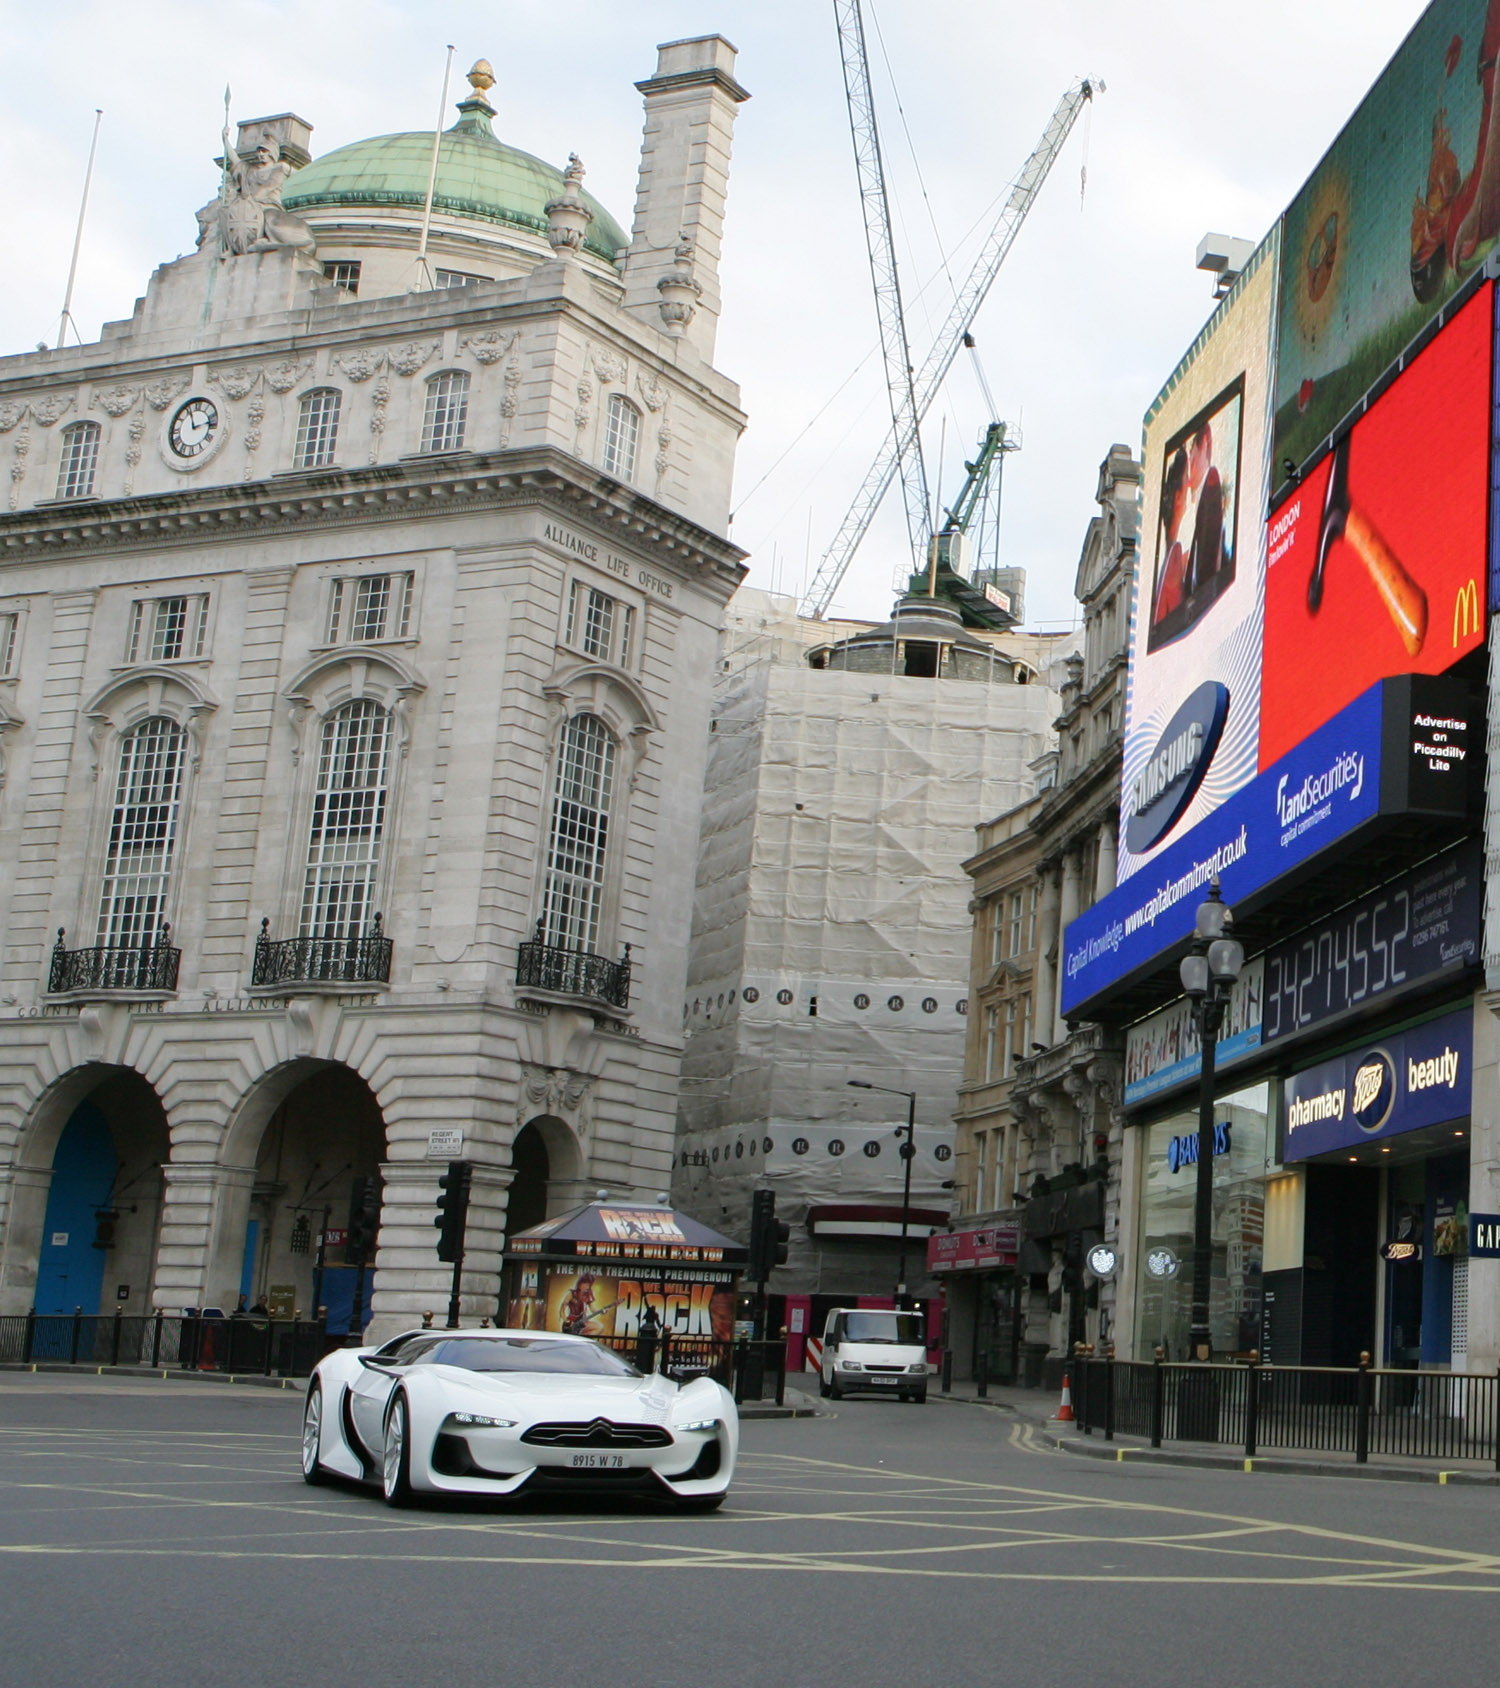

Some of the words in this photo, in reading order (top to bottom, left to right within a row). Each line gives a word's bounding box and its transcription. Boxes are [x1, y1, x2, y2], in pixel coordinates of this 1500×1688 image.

[1269, 500, 1301, 547] LONDON
[544, 524, 598, 562] ALLIANCE
[606, 554, 629, 577] LIFE
[638, 571, 673, 598] OFFICE
[1413, 714, 1467, 730] Advertise
[1432, 732, 1447, 742] on
[1413, 742, 1466, 760] Piccadilly
[1429, 758, 1450, 771] Lite
[1129, 722, 1203, 817] SAMSUNG
[1281, 751, 1358, 828] LandSecurities
[1280, 822, 1298, 847] capital
[1298, 802, 1331, 835] commitment
[1067, 940, 1089, 980] Capital
[1124, 824, 1248, 937] www.capitalcommitment.co.uk
[18, 1006, 82, 1018] COUNTY
[127, 1001, 165, 1013] FIRE
[202, 998, 291, 1012] ALLIANCE
[337, 994, 379, 1007] LIFE
[1290, 1088, 1346, 1135] pharmacy
[1353, 1063, 1384, 1114] Boots
[1408, 1046, 1459, 1093] beauty
[1179, 1122, 1231, 1167] BARYS
[599, 1209, 683, 1240] ROCK
[576, 1241, 592, 1255] WE
[596, 1241, 620, 1256] WILL
[624, 1243, 640, 1257] WE
[643, 1244, 667, 1258] WILL
[670, 1245, 699, 1260] ROCK
[1386, 1242, 1415, 1260] Boots
[556, 1264, 574, 1275] THE
[577, 1264, 602, 1276] ROCK
[606, 1266, 662, 1279] THEATRICAL
[665, 1269, 732, 1283] PHENOMENON!
[643, 1282, 661, 1292] WE
[664, 1282, 690, 1294] WILL
[613, 1281, 715, 1350] ROCK
[573, 1455, 595, 1467] 8915
[600, 1456, 608, 1466] W
[612, 1456, 623, 1467] 78
